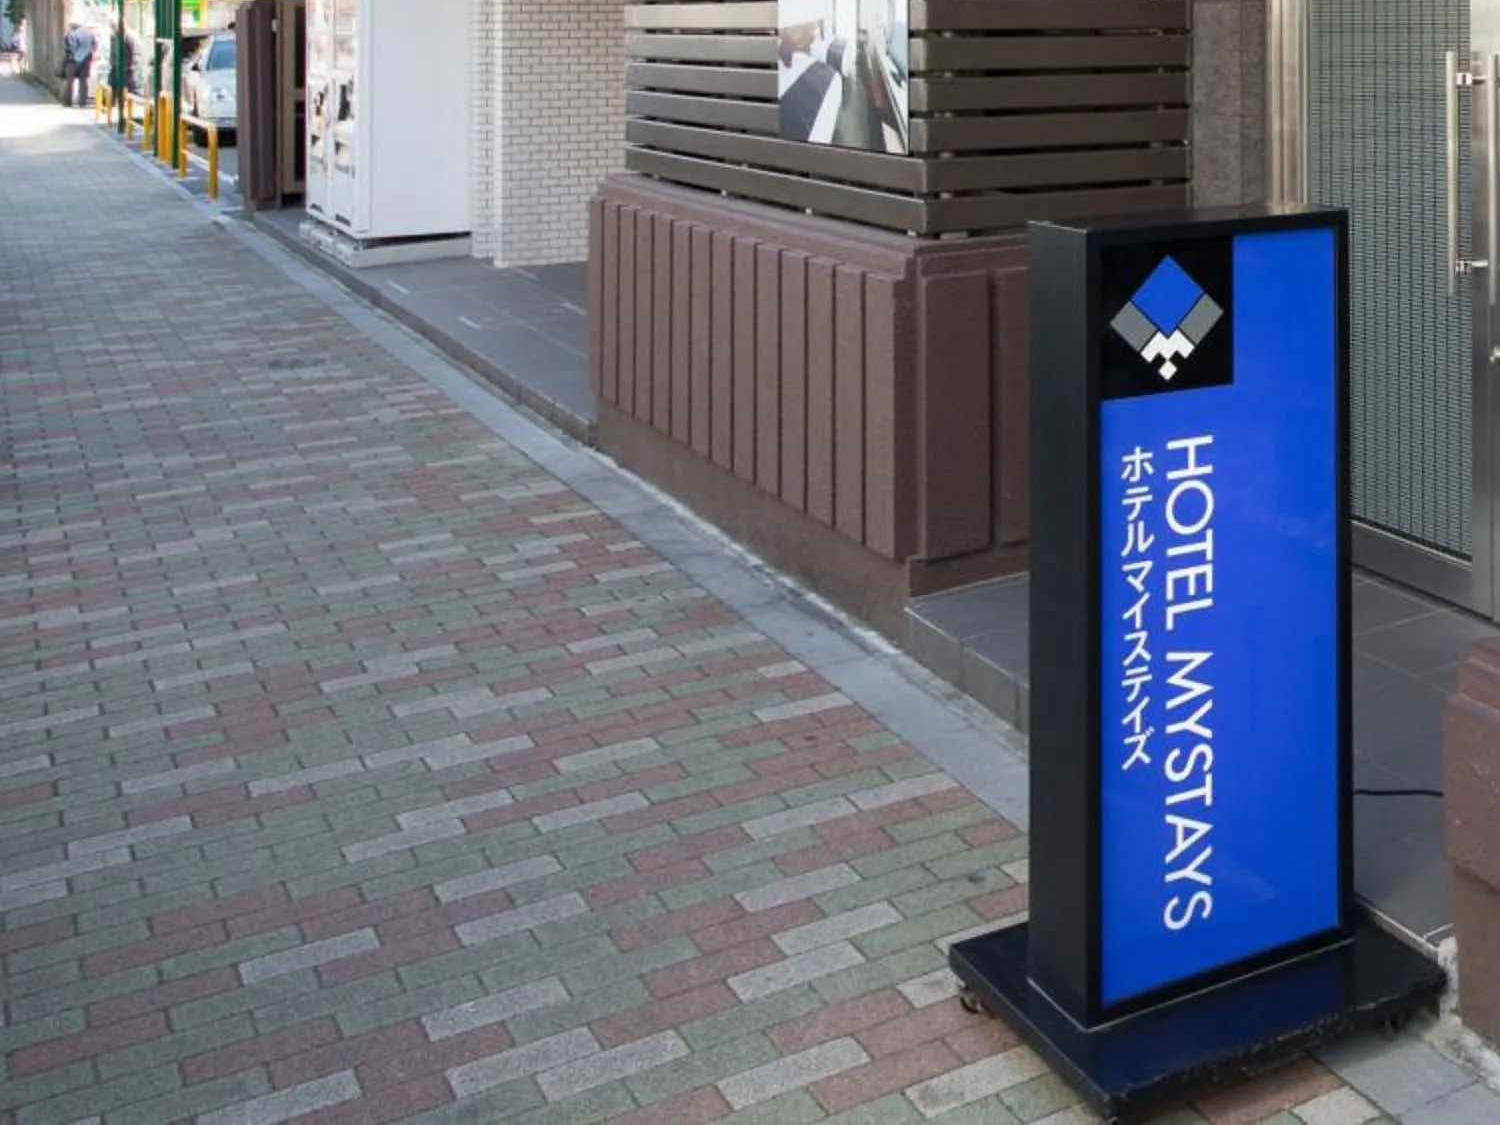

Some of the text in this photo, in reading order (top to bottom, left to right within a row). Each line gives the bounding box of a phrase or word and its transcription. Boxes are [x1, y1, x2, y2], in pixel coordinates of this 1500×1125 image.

[1121, 446, 1155, 770] ホテルマイステイズ
[1163, 434, 1215, 931] HOTEL MYSTAYS
